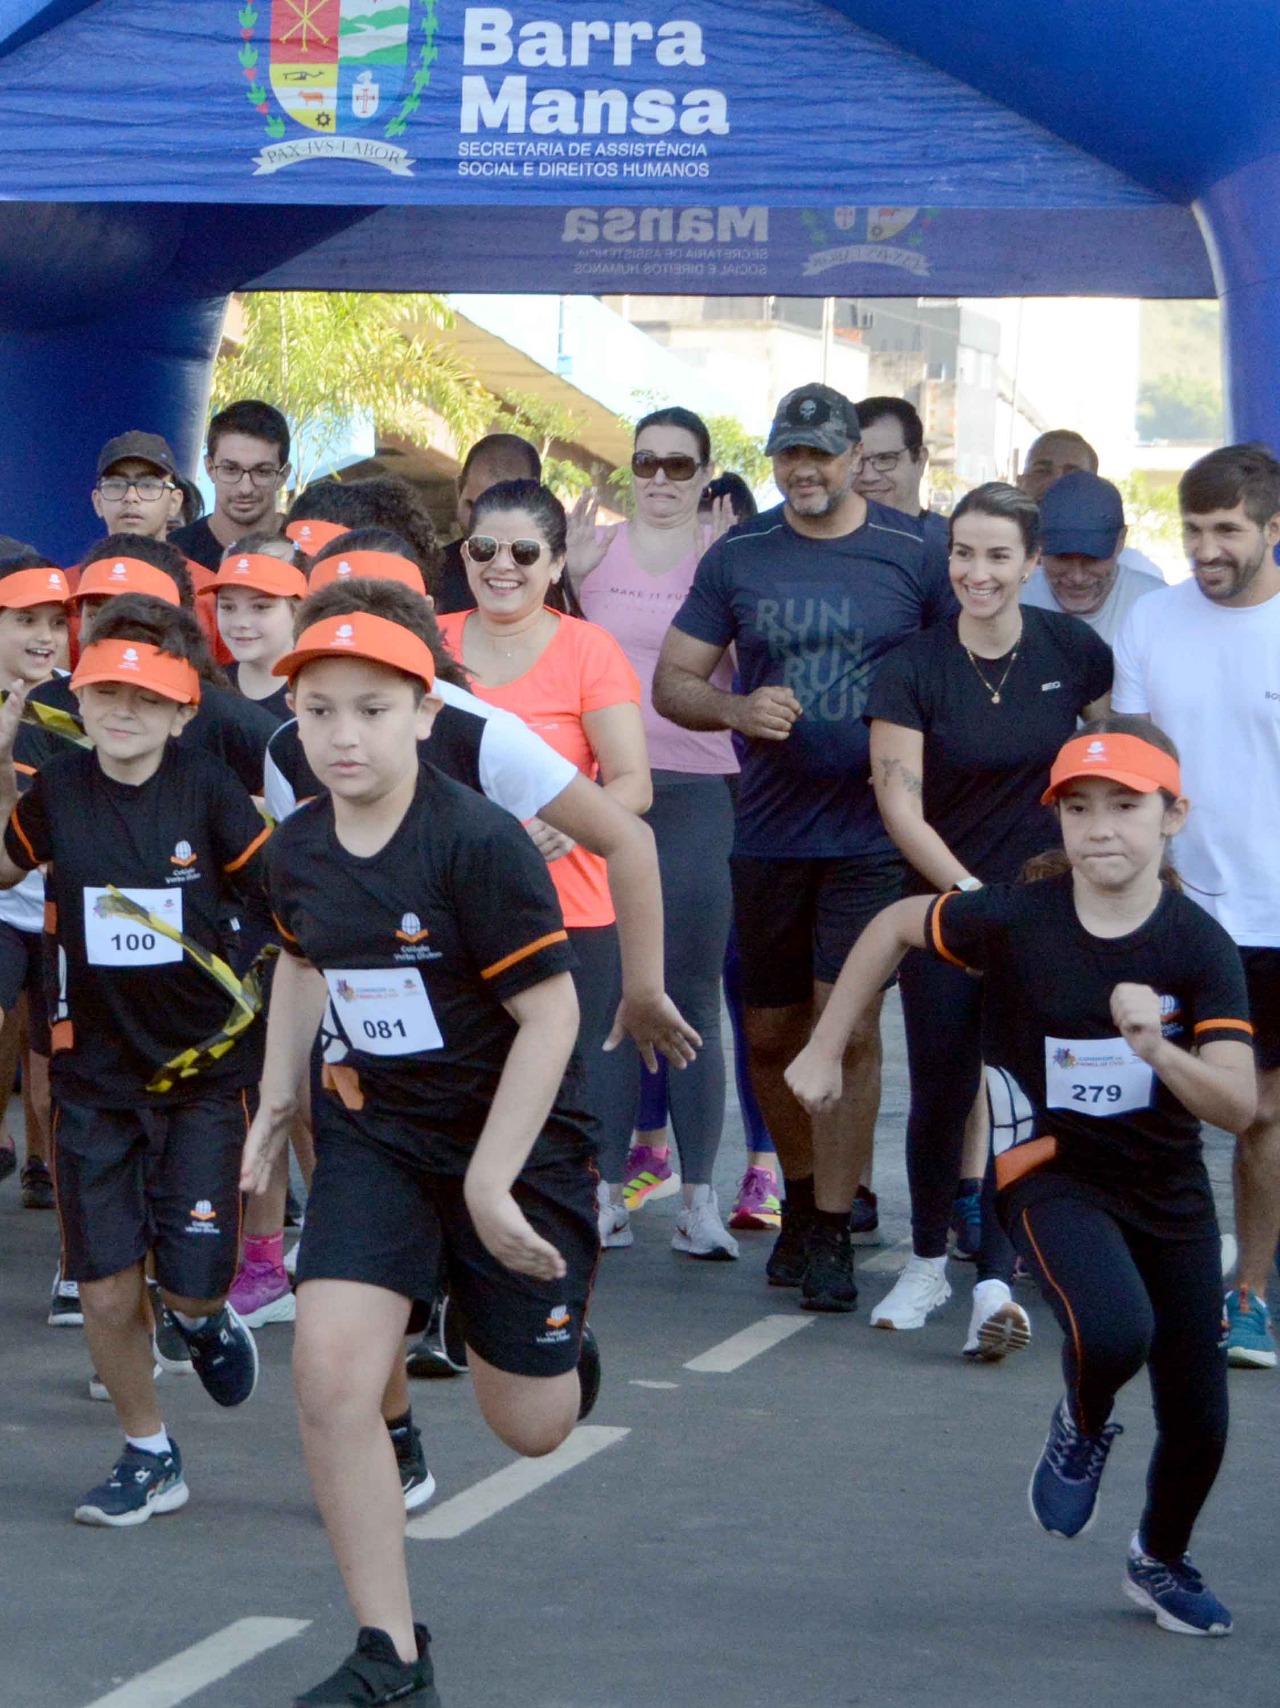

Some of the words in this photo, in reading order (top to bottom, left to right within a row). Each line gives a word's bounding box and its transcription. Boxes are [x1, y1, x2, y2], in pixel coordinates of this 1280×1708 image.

[463, 7, 706, 67] Barra
[460, 75, 730, 135] Mansa
[458, 142, 564, 157] SECRETARIA
[570, 142, 592, 157] DE
[595, 140, 707, 157] ASSISTÊNCIA
[458, 162, 518, 177] SOCIAL
[524, 162, 534, 177] E
[539, 162, 618, 177] DIREITOS
[623, 162, 709, 177] HUMANOS
[667, 593, 687, 601] FU
[756, 598, 850, 634] RUN
[768, 628, 864, 660] RUN
[783, 653, 870, 691] RUN
[111, 933, 156, 950] 100
[363, 1019, 407, 1039] 081
[1072, 1085, 1122, 1103] 279
